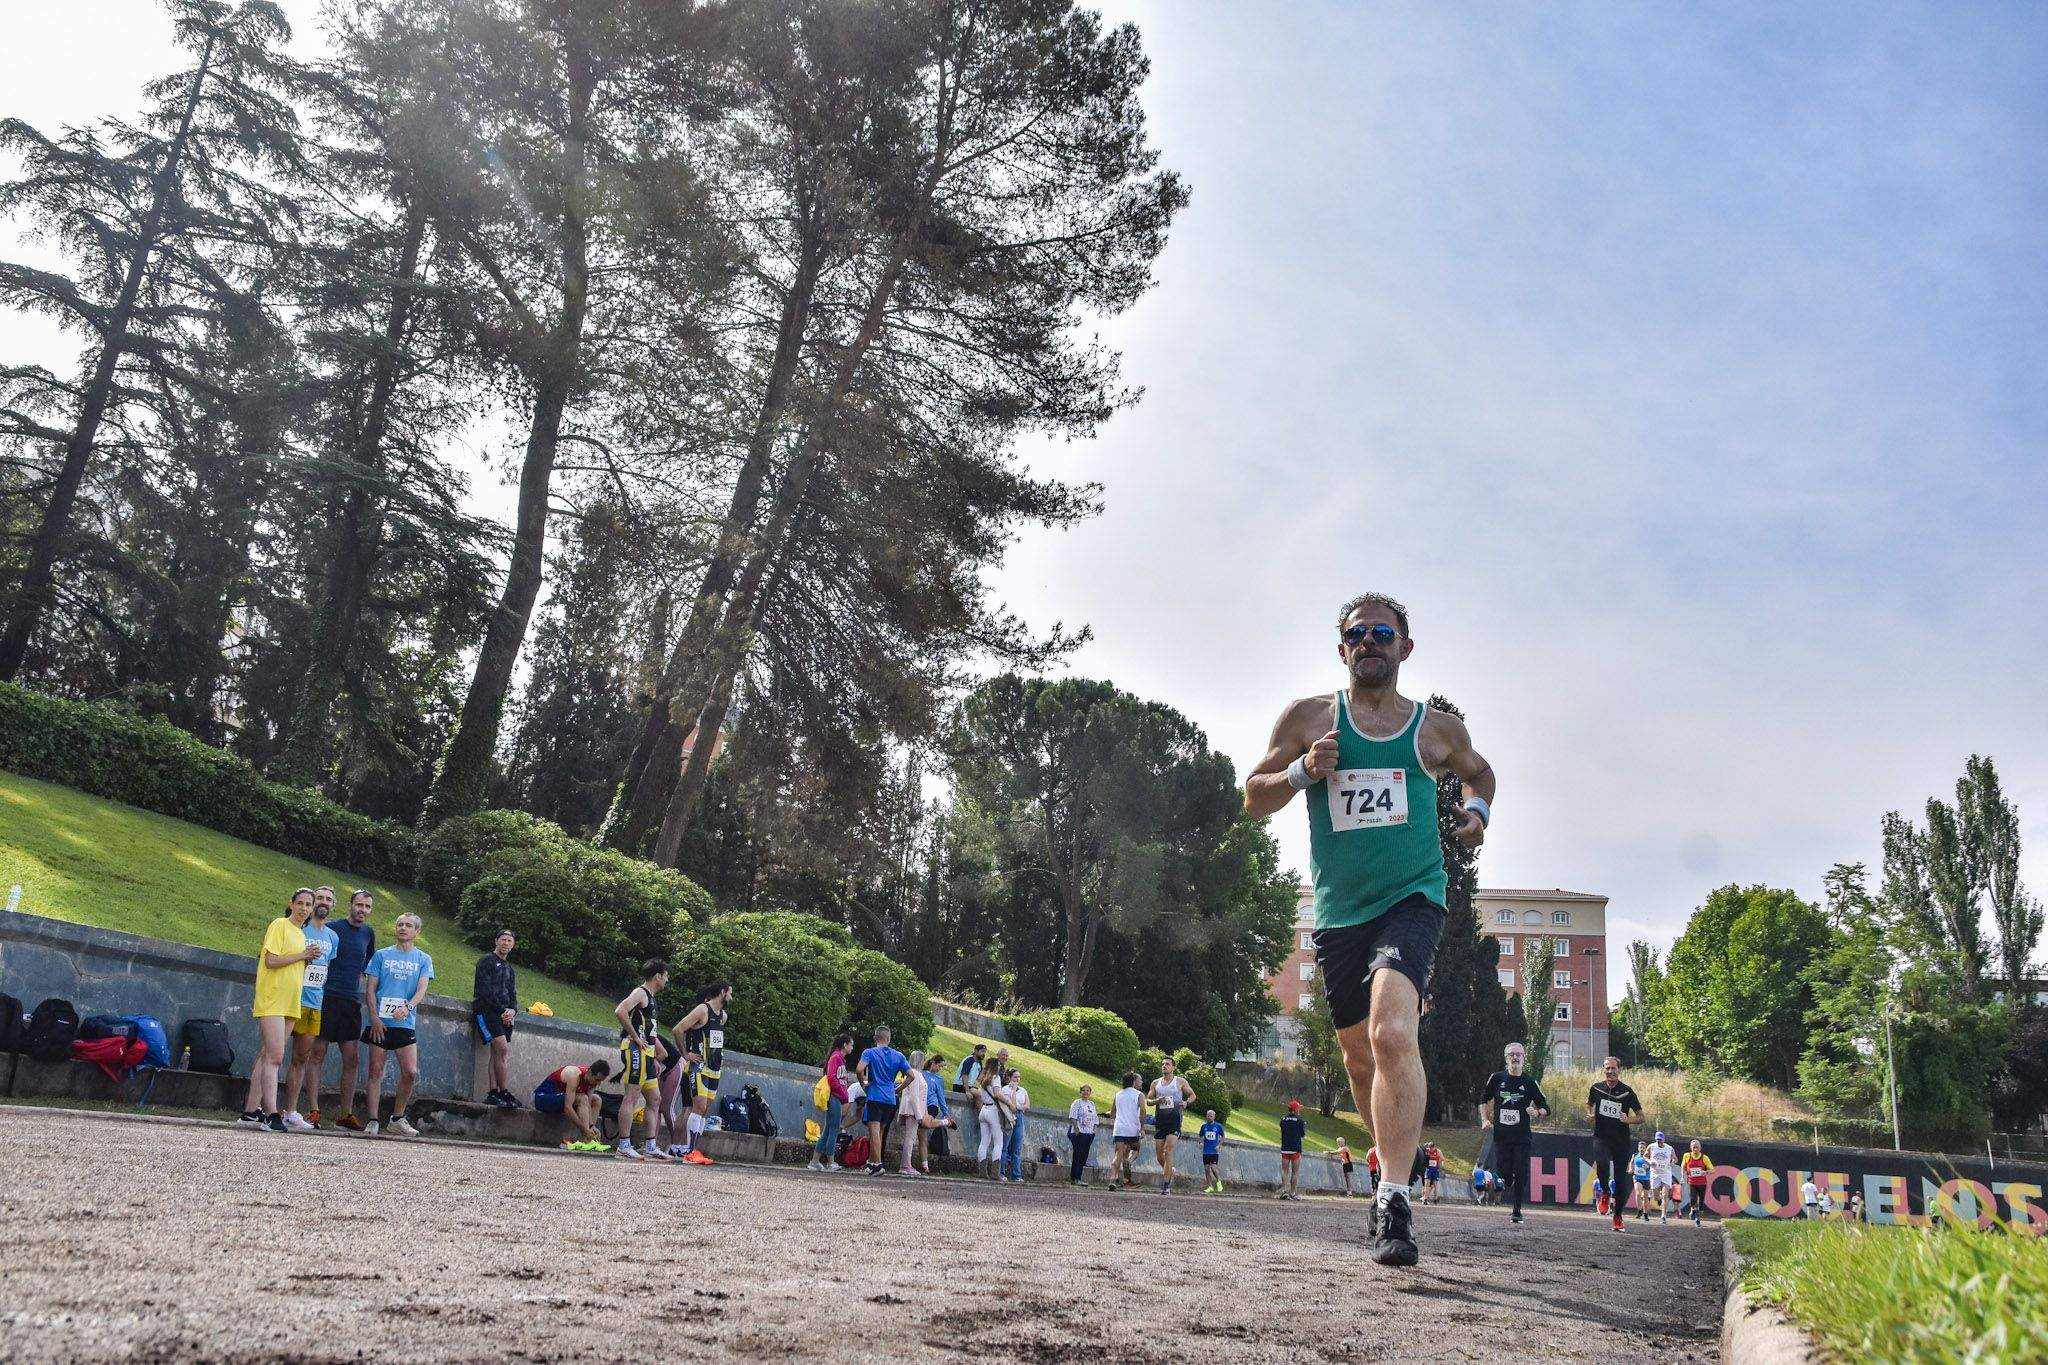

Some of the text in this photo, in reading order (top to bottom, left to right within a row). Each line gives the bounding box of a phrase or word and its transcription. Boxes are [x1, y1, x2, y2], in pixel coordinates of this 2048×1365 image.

[1341, 788, 1394, 815] 724
[384, 959, 420, 972] SPORT
[1603, 1105, 1617, 1115] 813
[1503, 1114, 1516, 1122] 709
